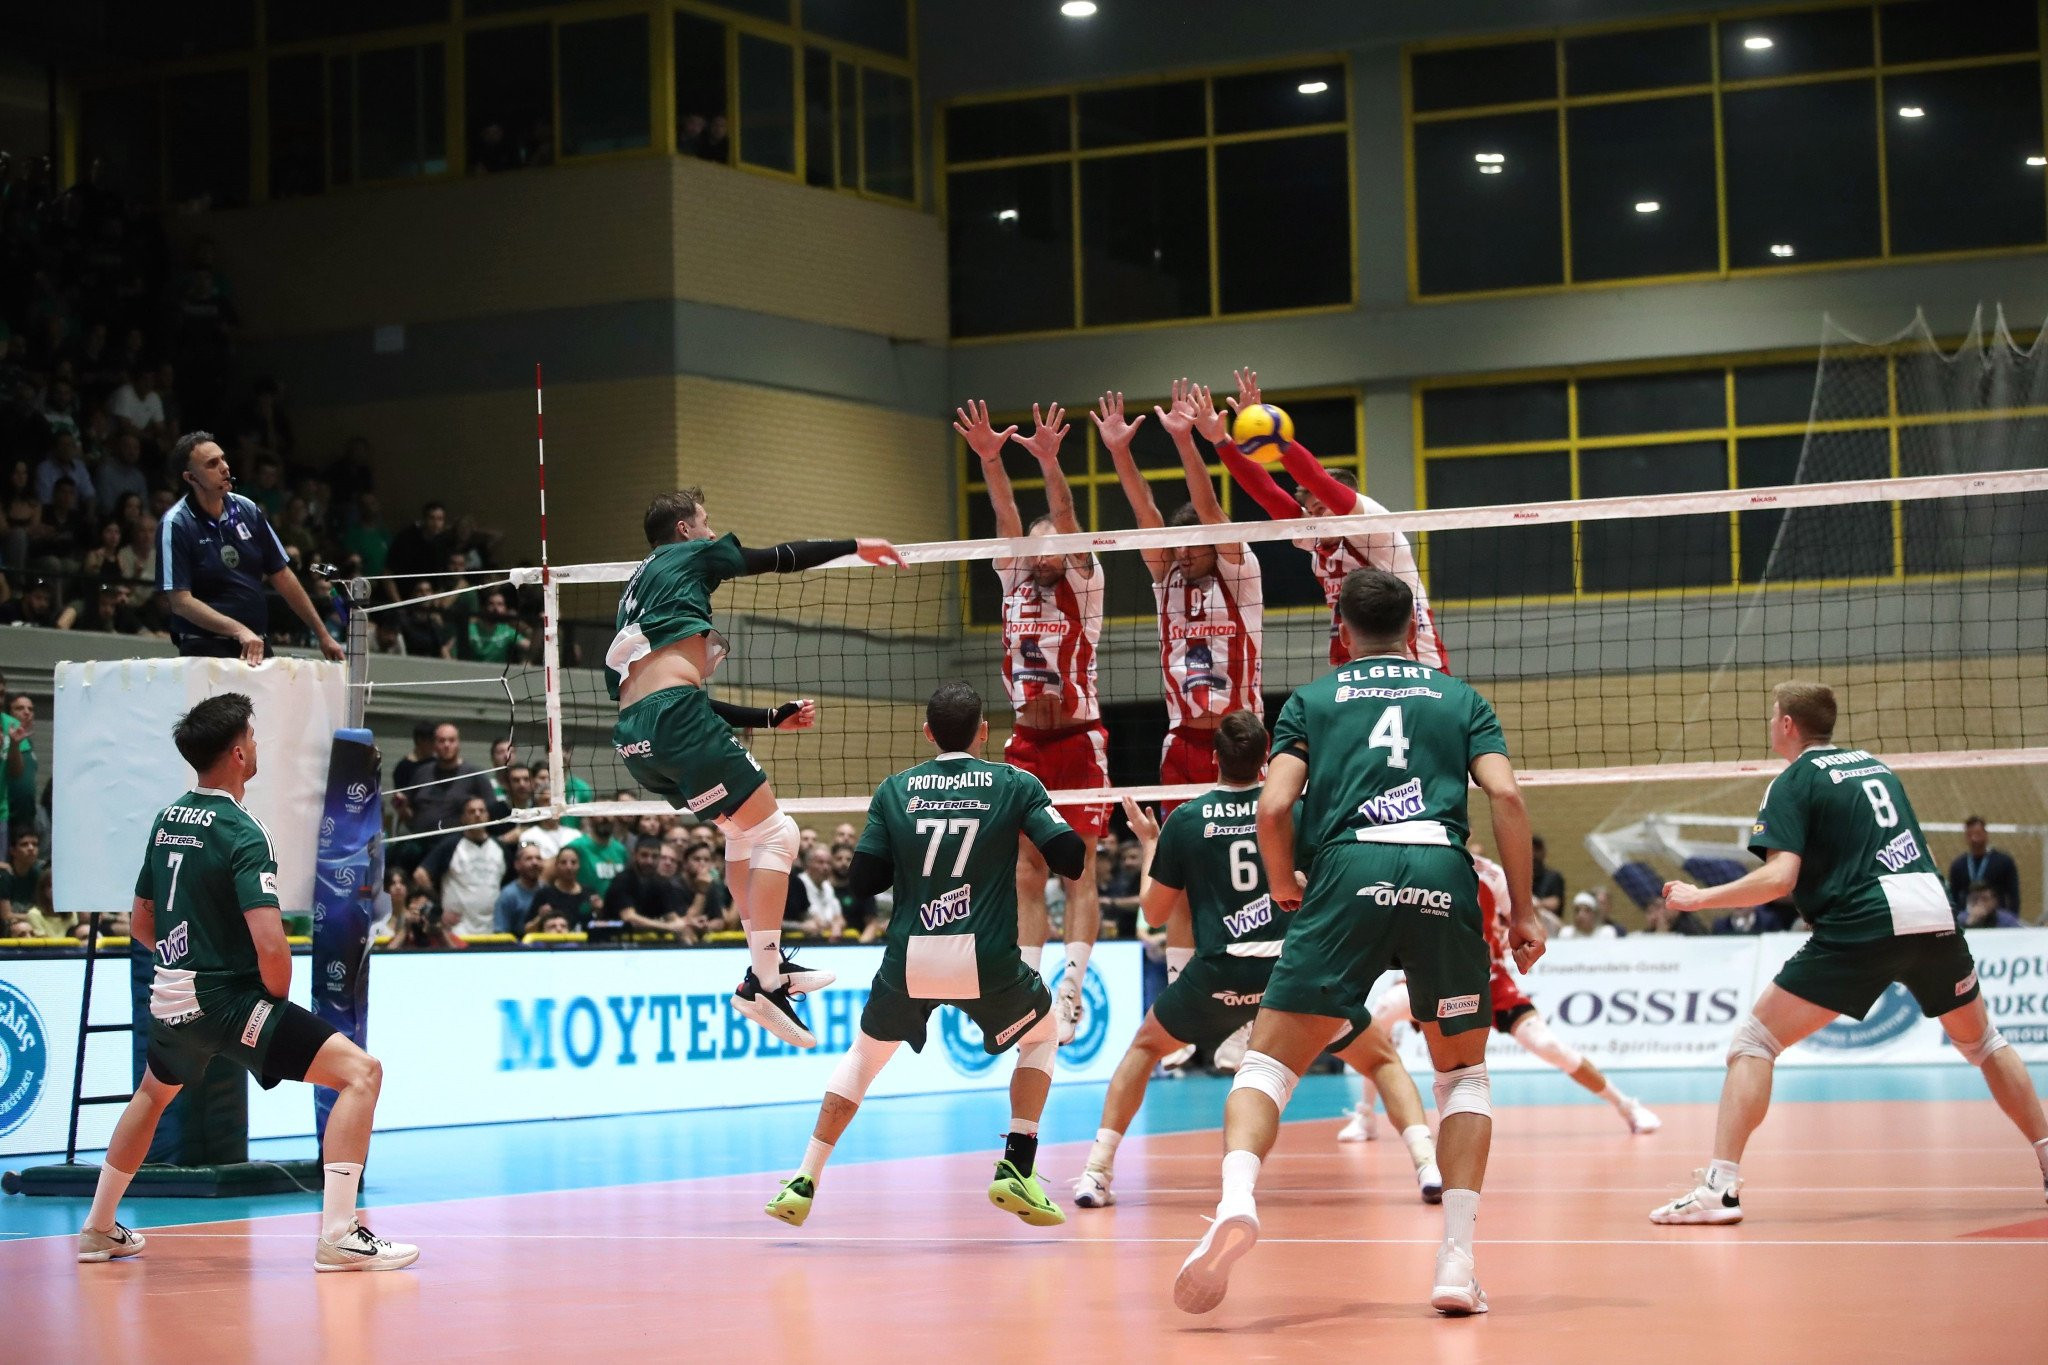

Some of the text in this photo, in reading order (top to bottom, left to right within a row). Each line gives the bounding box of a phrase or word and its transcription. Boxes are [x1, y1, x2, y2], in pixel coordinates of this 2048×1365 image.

[1190, 588, 1202, 617] 9
[1337, 665, 1433, 683] ELGERT
[1368, 705, 1410, 769] 4
[1811, 750, 1873, 769] BREUNIN
[907, 772, 993, 792] PROTOPSALTIS
[691, 788, 724, 807] BOLOSSIS
[1203, 800, 1258, 818] GASMA
[1362, 794, 1423, 824] Viva
[1862, 779, 1898, 827] 8
[1205, 823, 1257, 836] BATTERI
[916, 818, 980, 877] 77
[1879, 842, 1917, 871] Viva
[1229, 840, 1257, 891] 6
[167, 852, 183, 911] 7
[1375, 887, 1452, 909] avance
[920, 898, 968, 928] Viva
[1226, 906, 1270, 936] Viva
[1432, 909, 1450, 917] RENTAL
[1224, 993, 1264, 1006] avan
[1446, 1000, 1478, 1011] BOLOSSIS
[246, 1002, 268, 1040] BOLOSSIS
